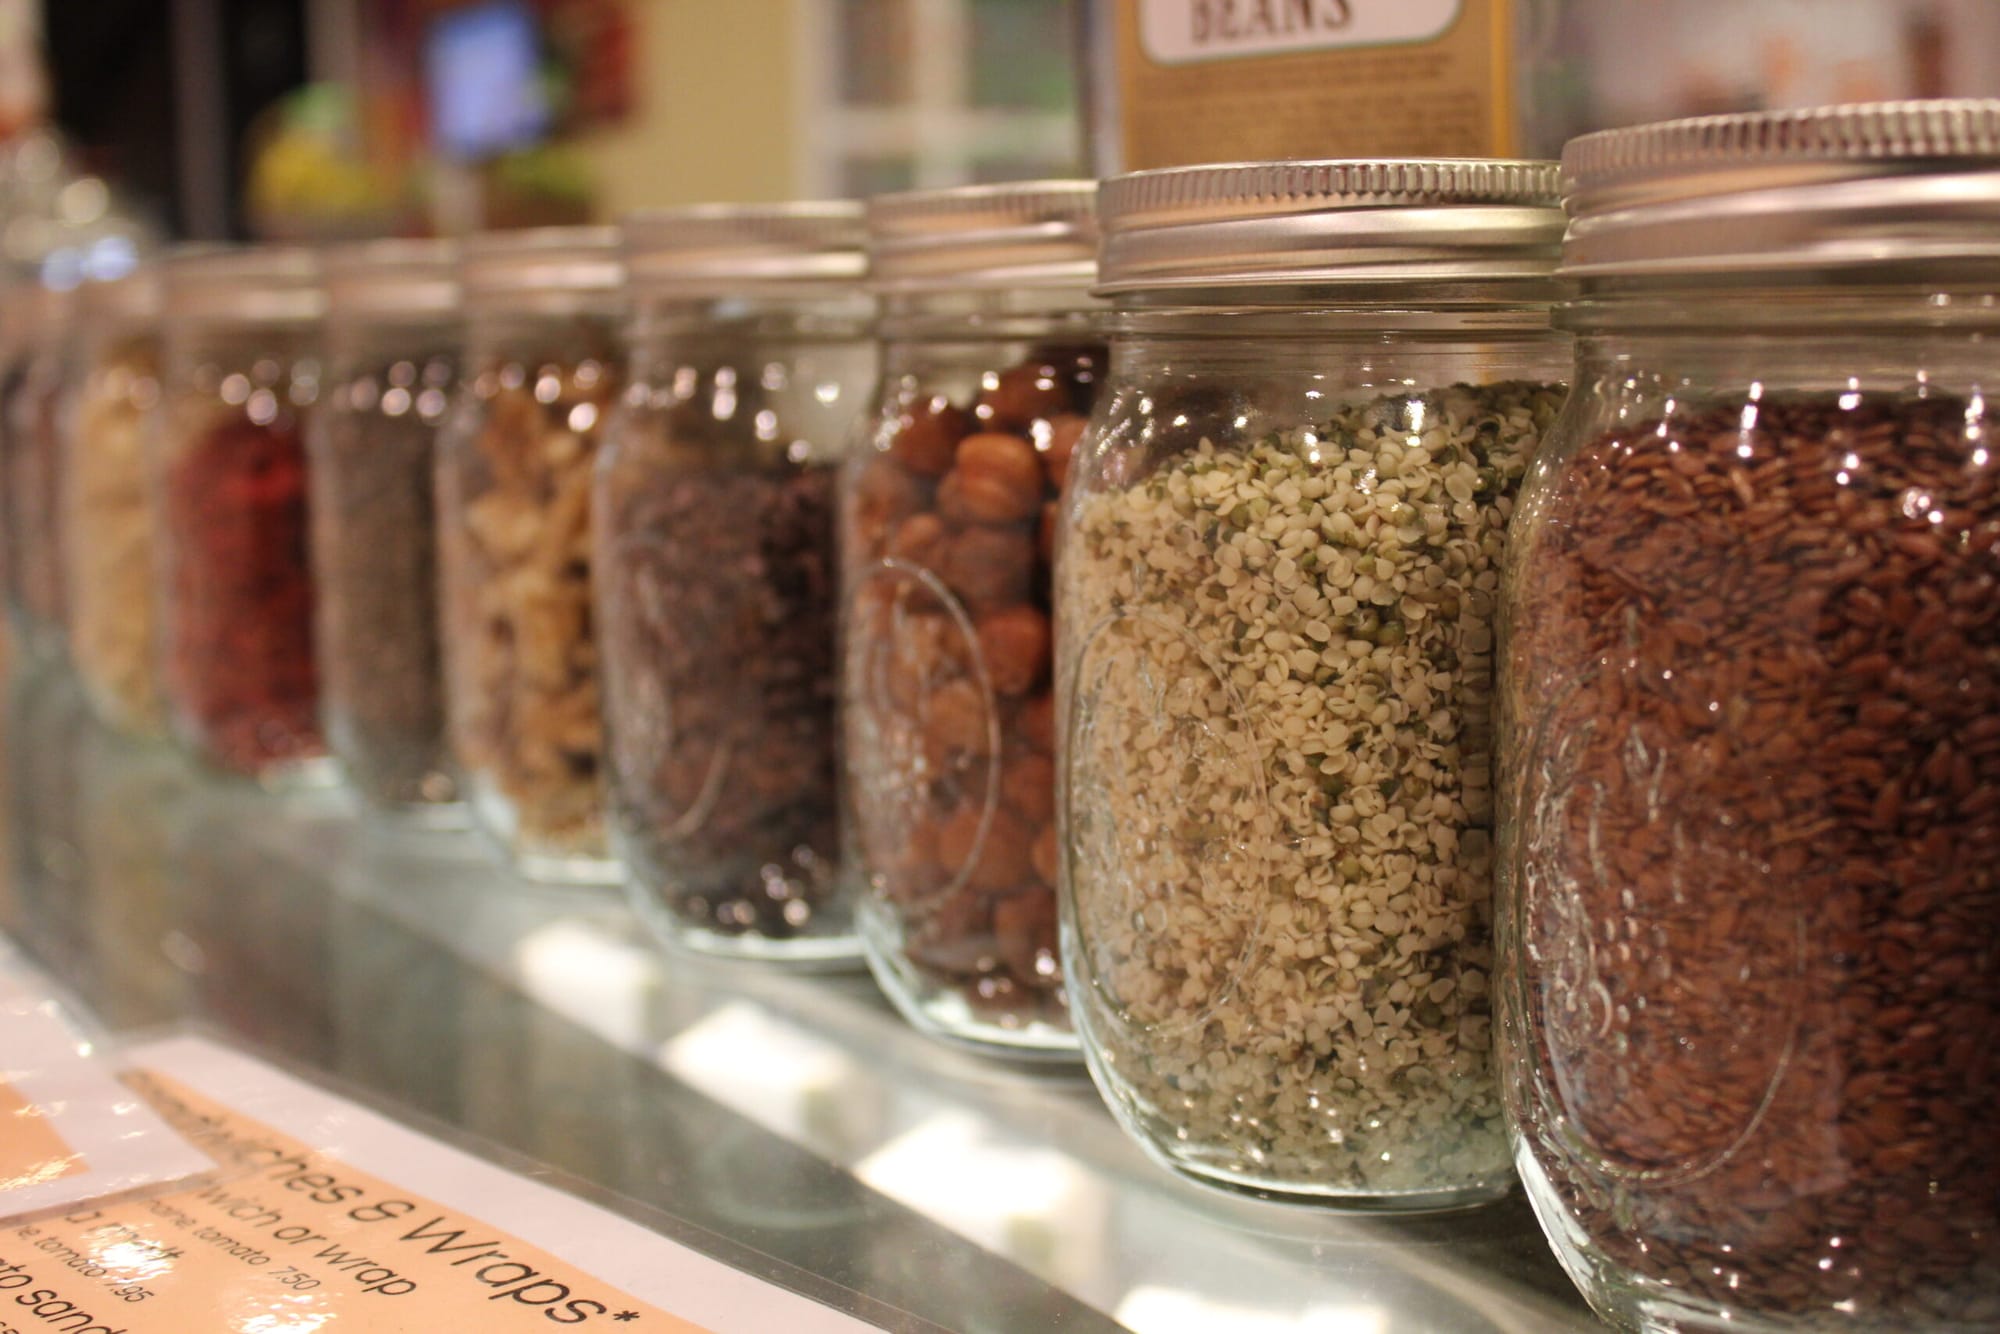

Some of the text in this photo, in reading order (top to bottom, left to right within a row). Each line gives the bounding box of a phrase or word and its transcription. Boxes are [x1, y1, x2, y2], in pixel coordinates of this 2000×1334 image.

[1190, 0, 1353, 46] BEANS
[346, 1198, 416, 1223] &
[33, 1235, 108, 1278] tomato
[191, 1226, 272, 1266] tomato
[267, 1265, 322, 1292] 7.50
[272, 1226, 328, 1246] or
[313, 1243, 418, 1297] wrap
